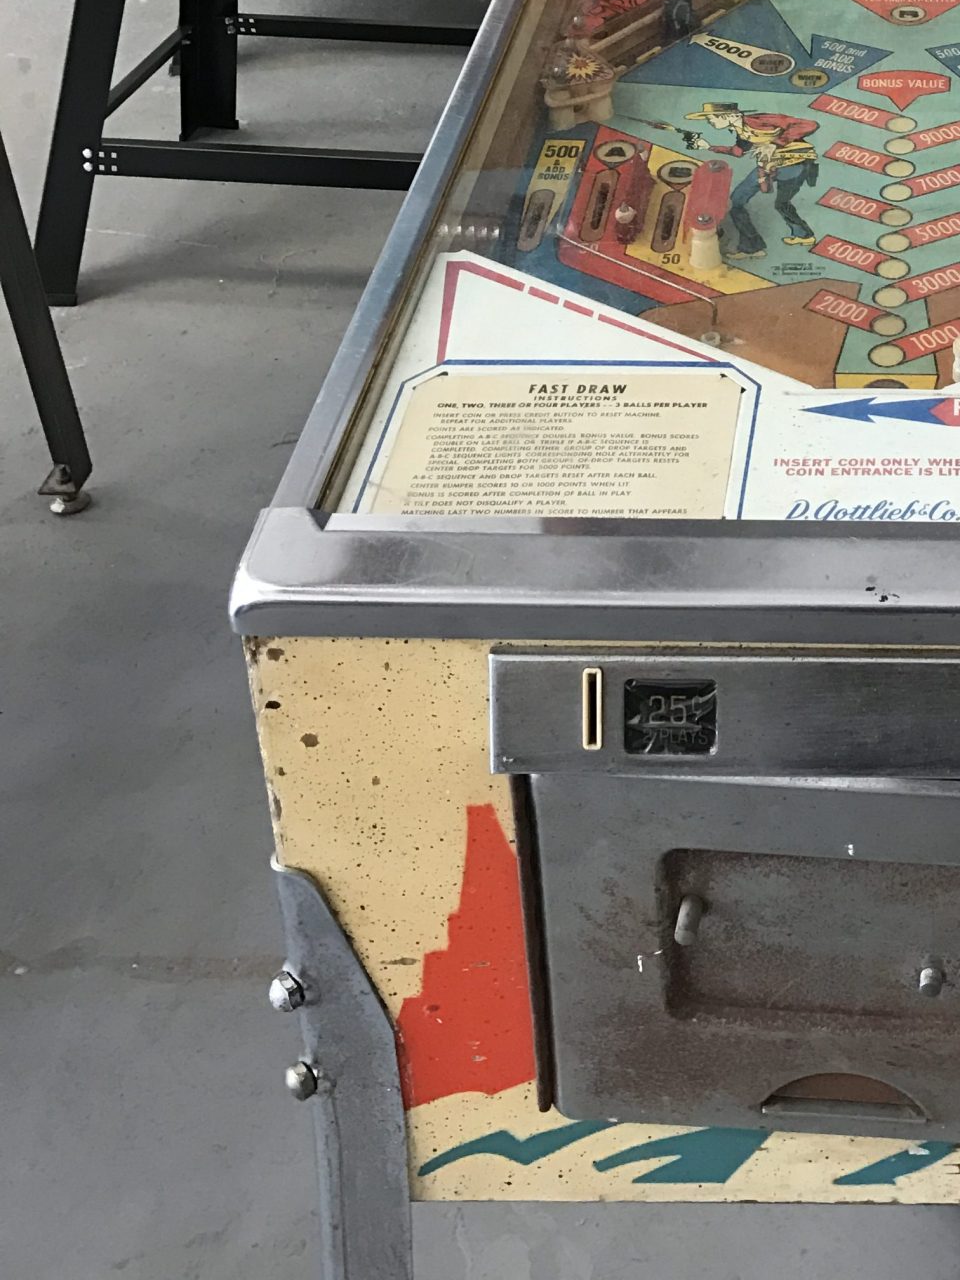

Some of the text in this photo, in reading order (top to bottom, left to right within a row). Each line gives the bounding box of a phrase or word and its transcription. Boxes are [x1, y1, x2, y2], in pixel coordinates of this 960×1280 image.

[703, 37, 753, 59] 5000
[821, 40, 867, 58] 500 and
[935, 46, 960, 59] 500
[814, 58, 856, 74] BONUS
[829, 53, 855, 64] ADD
[862, 78, 946, 89] BONUS VALUE
[544, 144, 580, 159] 500
[835, 145, 880, 168] 8000
[544, 166, 565, 174] ADD
[829, 192, 877, 216] 6000
[661, 253, 681, 265] 50
[827, 240, 875, 266] 4000
[815, 295, 868, 323] 2000
[528, 383, 628, 394] FAST DRAW
[773, 458, 832, 467] INSERT
[838, 458, 877, 467] COIN
[881, 458, 920, 468] ONLY
[785, 467, 826, 476] COIN
[830, 467, 913, 476] ENTRANCE
[919, 467, 934, 476] IS
[659, 727, 709, 745] PLAYS
